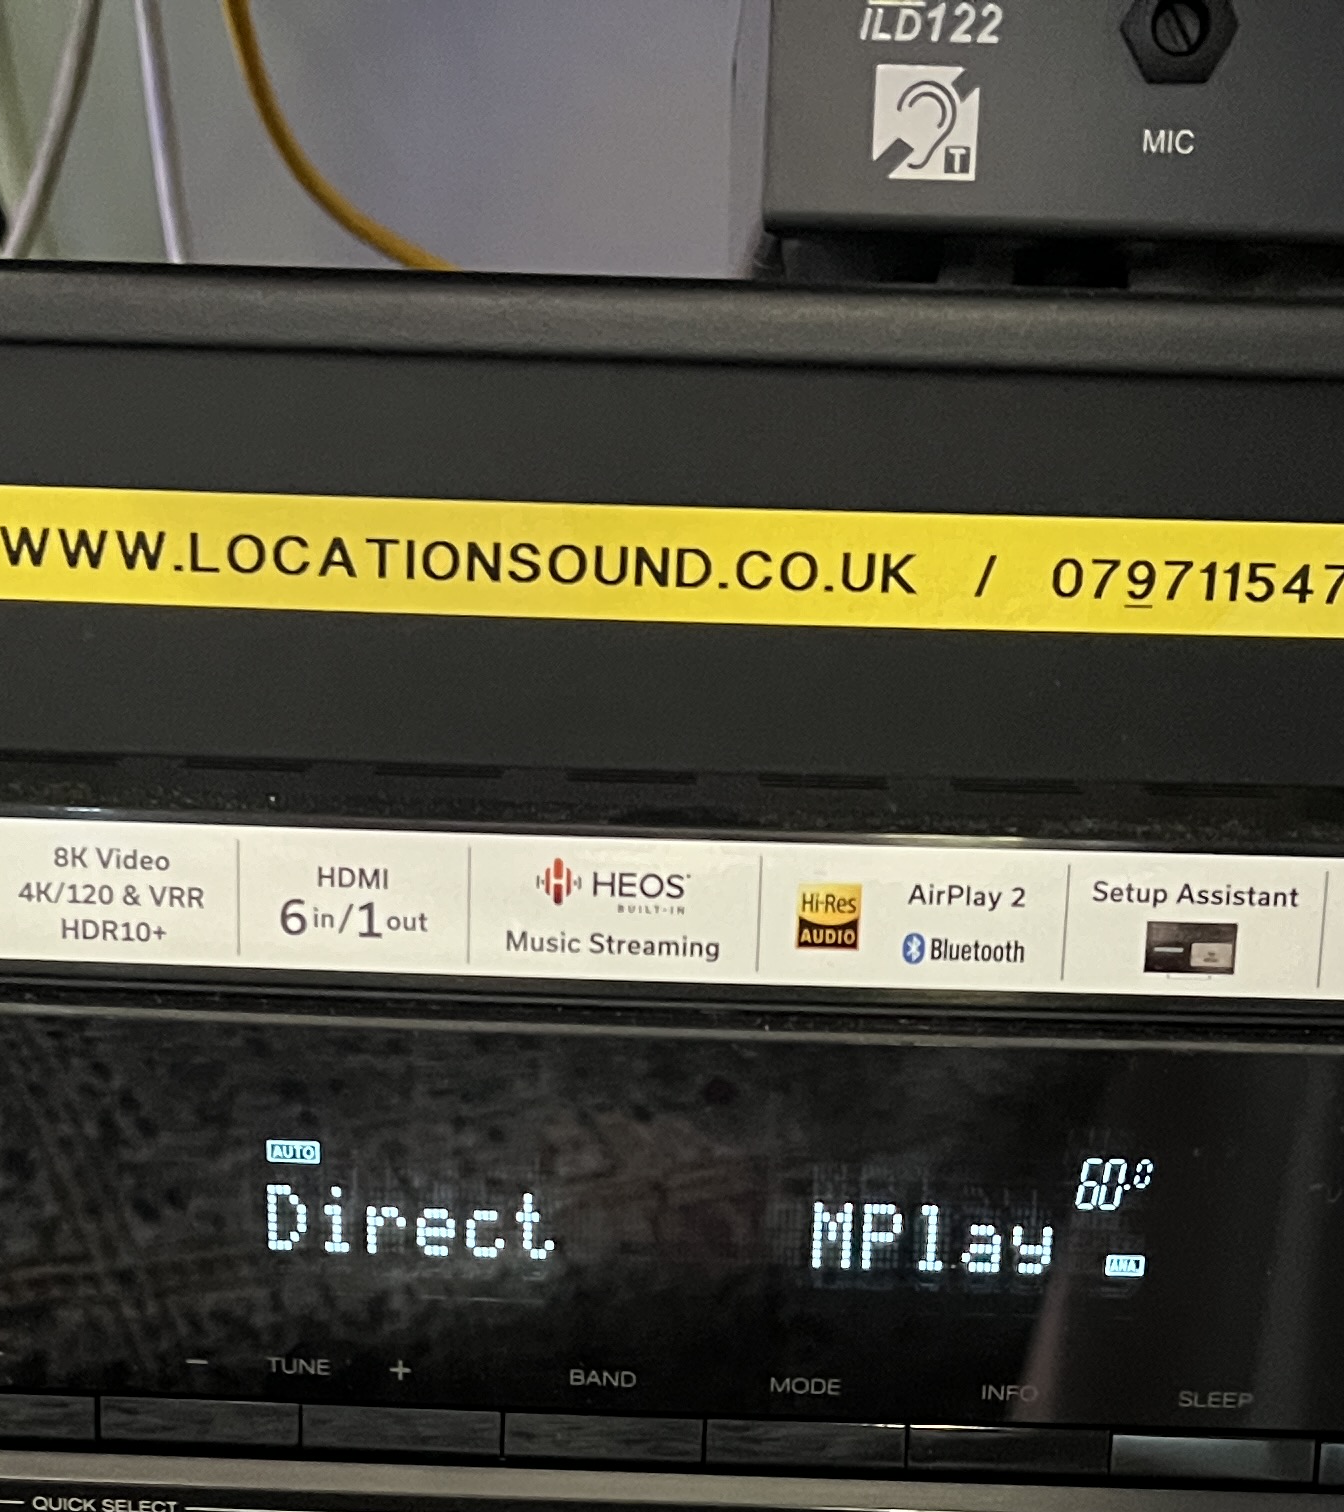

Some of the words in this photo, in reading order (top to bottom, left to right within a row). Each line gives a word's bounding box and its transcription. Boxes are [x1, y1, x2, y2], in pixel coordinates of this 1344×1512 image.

[860, 2, 1003, 43] ILD122
[1144, 130, 1194, 154] MIC
[54, 846, 88, 870] 8K
[96, 849, 170, 872] Video
[317, 866, 389, 890] HDMI
[593, 871, 684, 899] HEOS
[18, 881, 117, 907] 4K/120
[124, 885, 141, 907] &
[148, 886, 204, 910] VRR
[800, 891, 857, 916] Hi-Res
[908, 883, 1004, 912] AirPlay
[1010, 888, 1026, 908] 2
[1092, 881, 1167, 905] Setup
[1176, 883, 1299, 908] Assistant
[61, 918, 167, 943] HDR10+
[799, 927, 857, 948] AUDIO
[506, 931, 584, 957] Music
[589, 933, 720, 961] Streaming
[930, 938, 1025, 965] Bluetooth
[273, 1144, 315, 1160] AUTO
[266, 1184, 555, 1261] Direct
[812, 1202, 1053, 1274] MPlay
[268, 1355, 332, 1377] TUNE
[569, 1368, 636, 1388] BAND
[769, 1376, 842, 1396] MODE
[981, 1385, 1037, 1402] INFO
[1177, 1390, 1253, 1409] SLEEP
